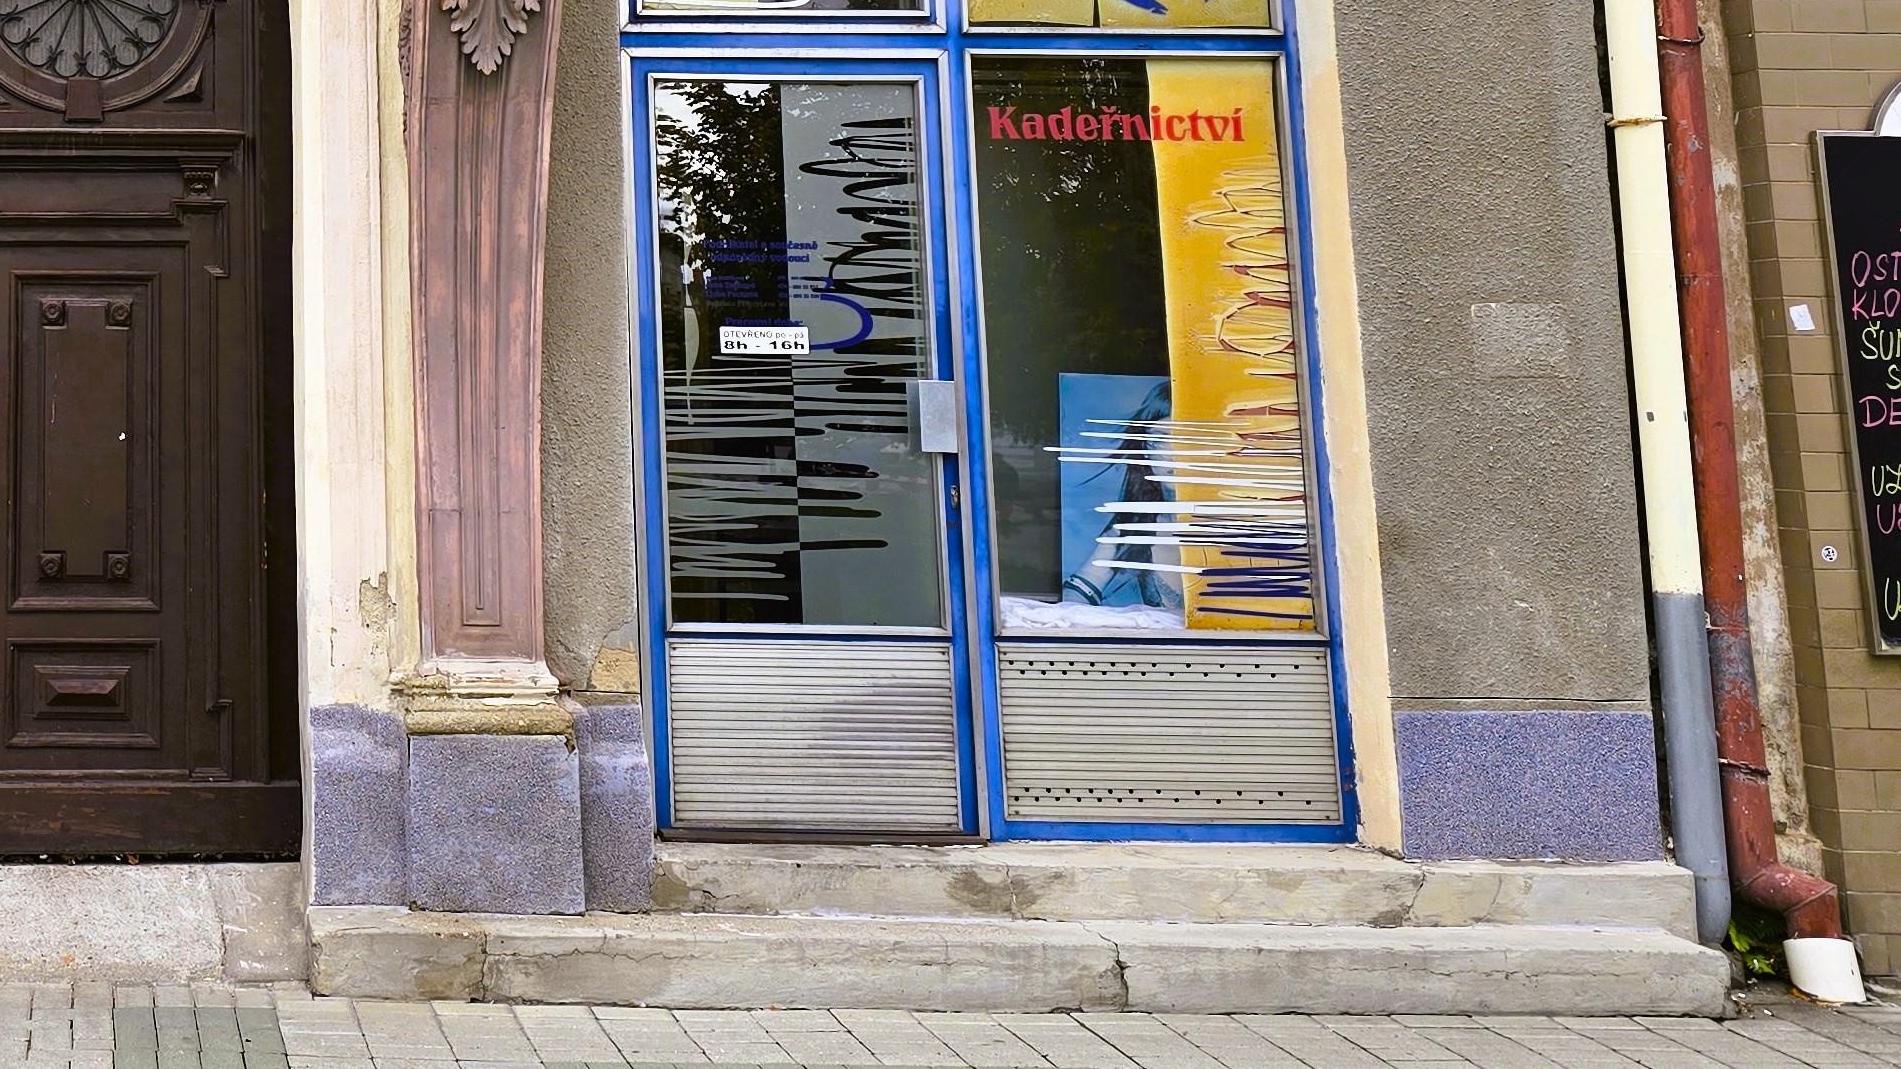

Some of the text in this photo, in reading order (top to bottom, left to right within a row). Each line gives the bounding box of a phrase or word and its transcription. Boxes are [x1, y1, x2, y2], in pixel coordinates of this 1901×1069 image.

[987, 105, 1245, 142] Kadeřnictví
[724, 340, 747, 350] 8h
[769, 340, 805, 350] 16h
